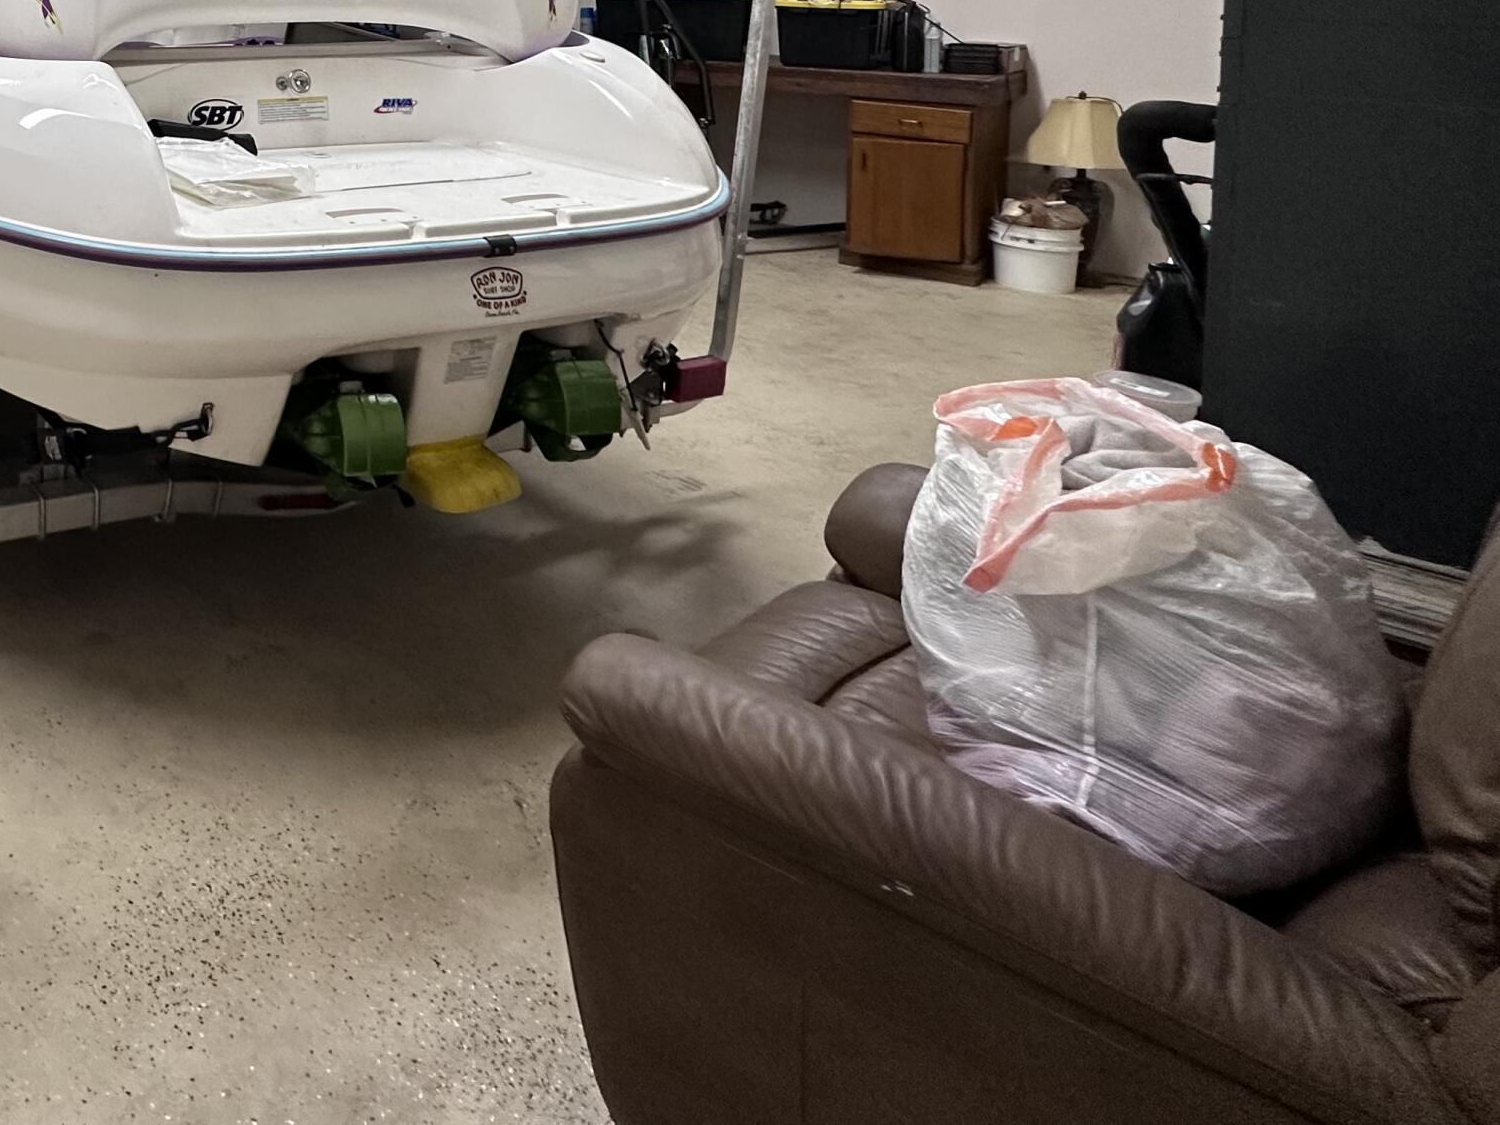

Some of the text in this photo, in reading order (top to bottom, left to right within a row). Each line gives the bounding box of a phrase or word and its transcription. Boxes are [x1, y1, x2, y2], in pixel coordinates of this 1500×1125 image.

[382, 98, 413, 108] RIVA
[191, 105, 243, 125] SBT
[476, 271, 519, 289] RON JON
[476, 299, 491, 309] ONE
[493, 301, 503, 310] OF
[504, 301, 510, 309] A
